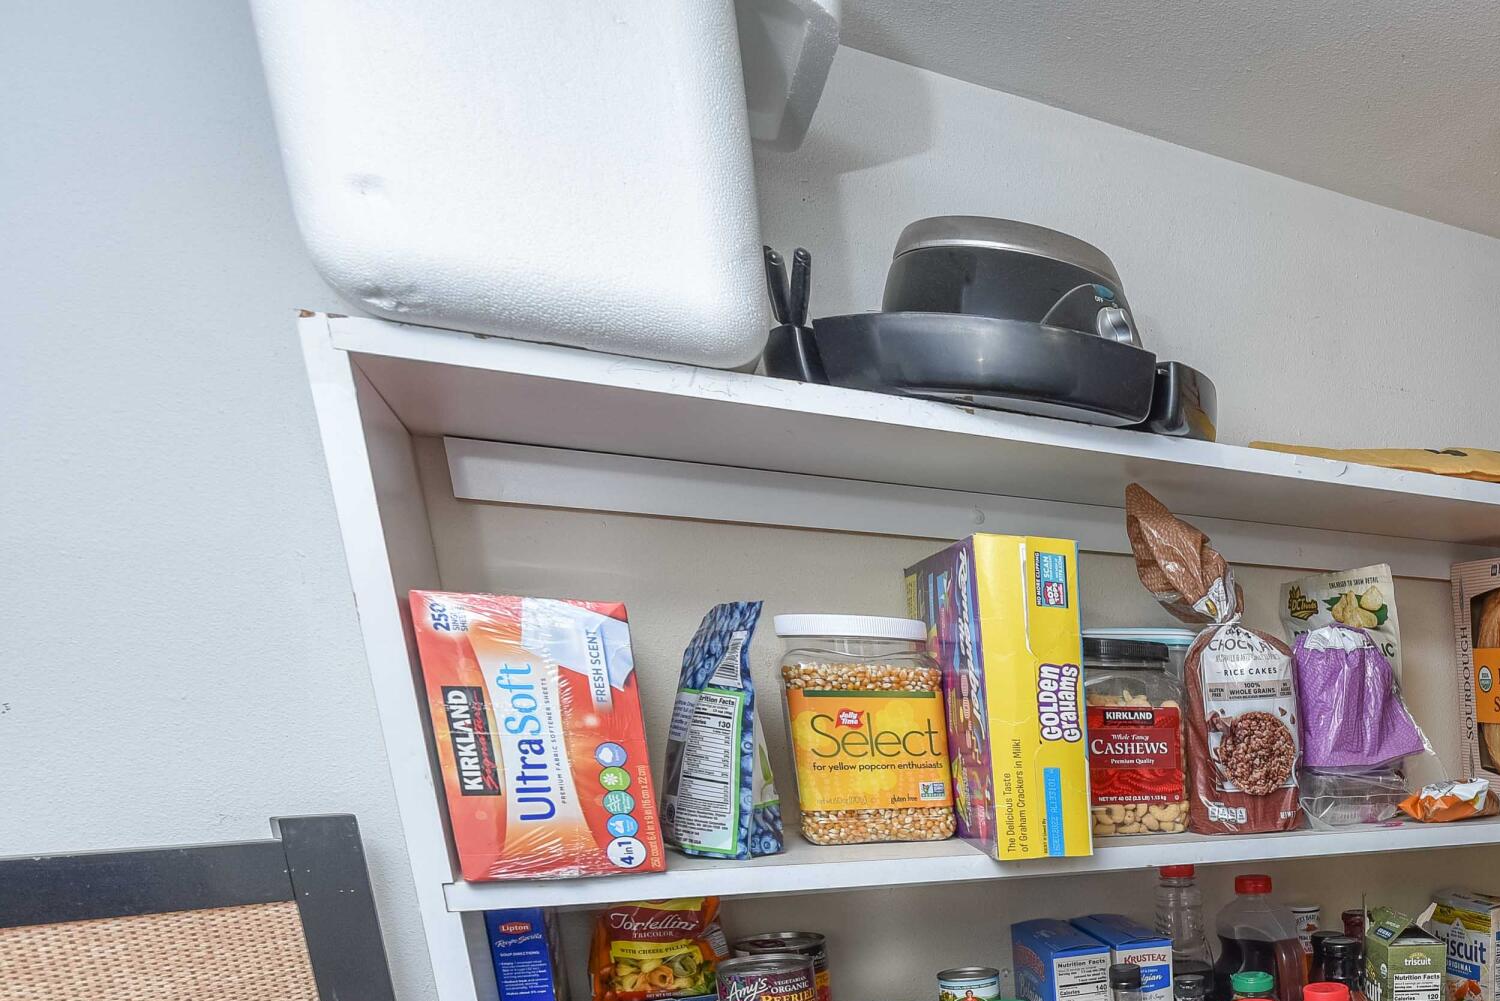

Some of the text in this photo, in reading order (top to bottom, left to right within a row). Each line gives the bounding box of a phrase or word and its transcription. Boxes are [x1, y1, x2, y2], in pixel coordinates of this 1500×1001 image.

[588, 629, 608, 704] FRESH SCENT
[1248, 667, 1277, 675] CAKES
[1461, 626, 1475, 740] SOURDOUGH
[1105, 711, 1152, 722] KIRKLAND
[447, 689, 483, 791] KIRKLAND
[811, 712, 942, 757] Select
[496, 662, 556, 821] UltraSoft
[1091, 739, 1168, 755] CASHEWS
[812, 760, 944, 773] for yellow popcorn enthusiasts
[1110, 758, 1156, 766] Premium Quality
[1003, 773, 1016, 854] The Delicious Taste
[1017, 777, 1029, 854] of Graham Crackers
[621, 853, 635, 865] 4
[501, 924, 529, 933] Lipton
[610, 913, 699, 932] Tortellini
[632, 931, 674, 939] TRICOLOR
[1057, 960, 1086, 969] Nutrition
[1123, 954, 1167, 965] KRUSTEAZ
[1404, 957, 1432, 966] triscuit
[774, 976, 807, 986] VEGETARIAN
[770, 981, 810, 994] ORGANIC
[1095, 984, 1108, 992] 140
